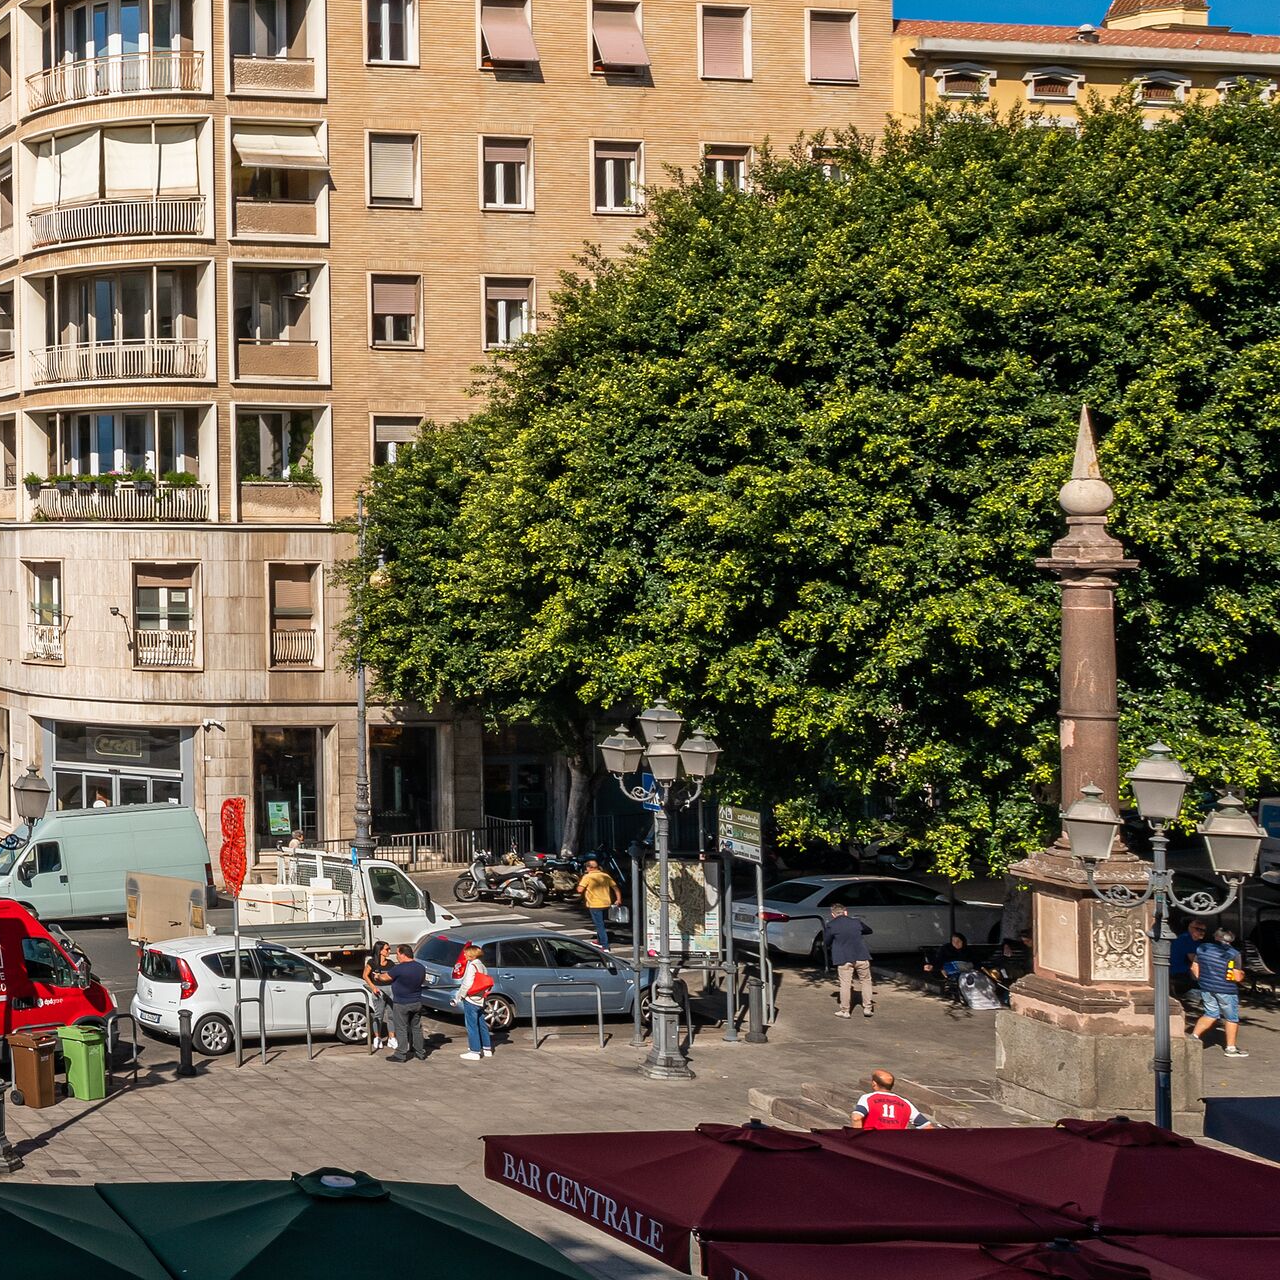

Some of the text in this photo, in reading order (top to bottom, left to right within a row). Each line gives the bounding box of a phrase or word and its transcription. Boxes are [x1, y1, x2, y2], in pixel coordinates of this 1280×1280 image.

[882, 1103, 895, 1119] 11
[502, 1151, 665, 1254] BAR CENTRALE
